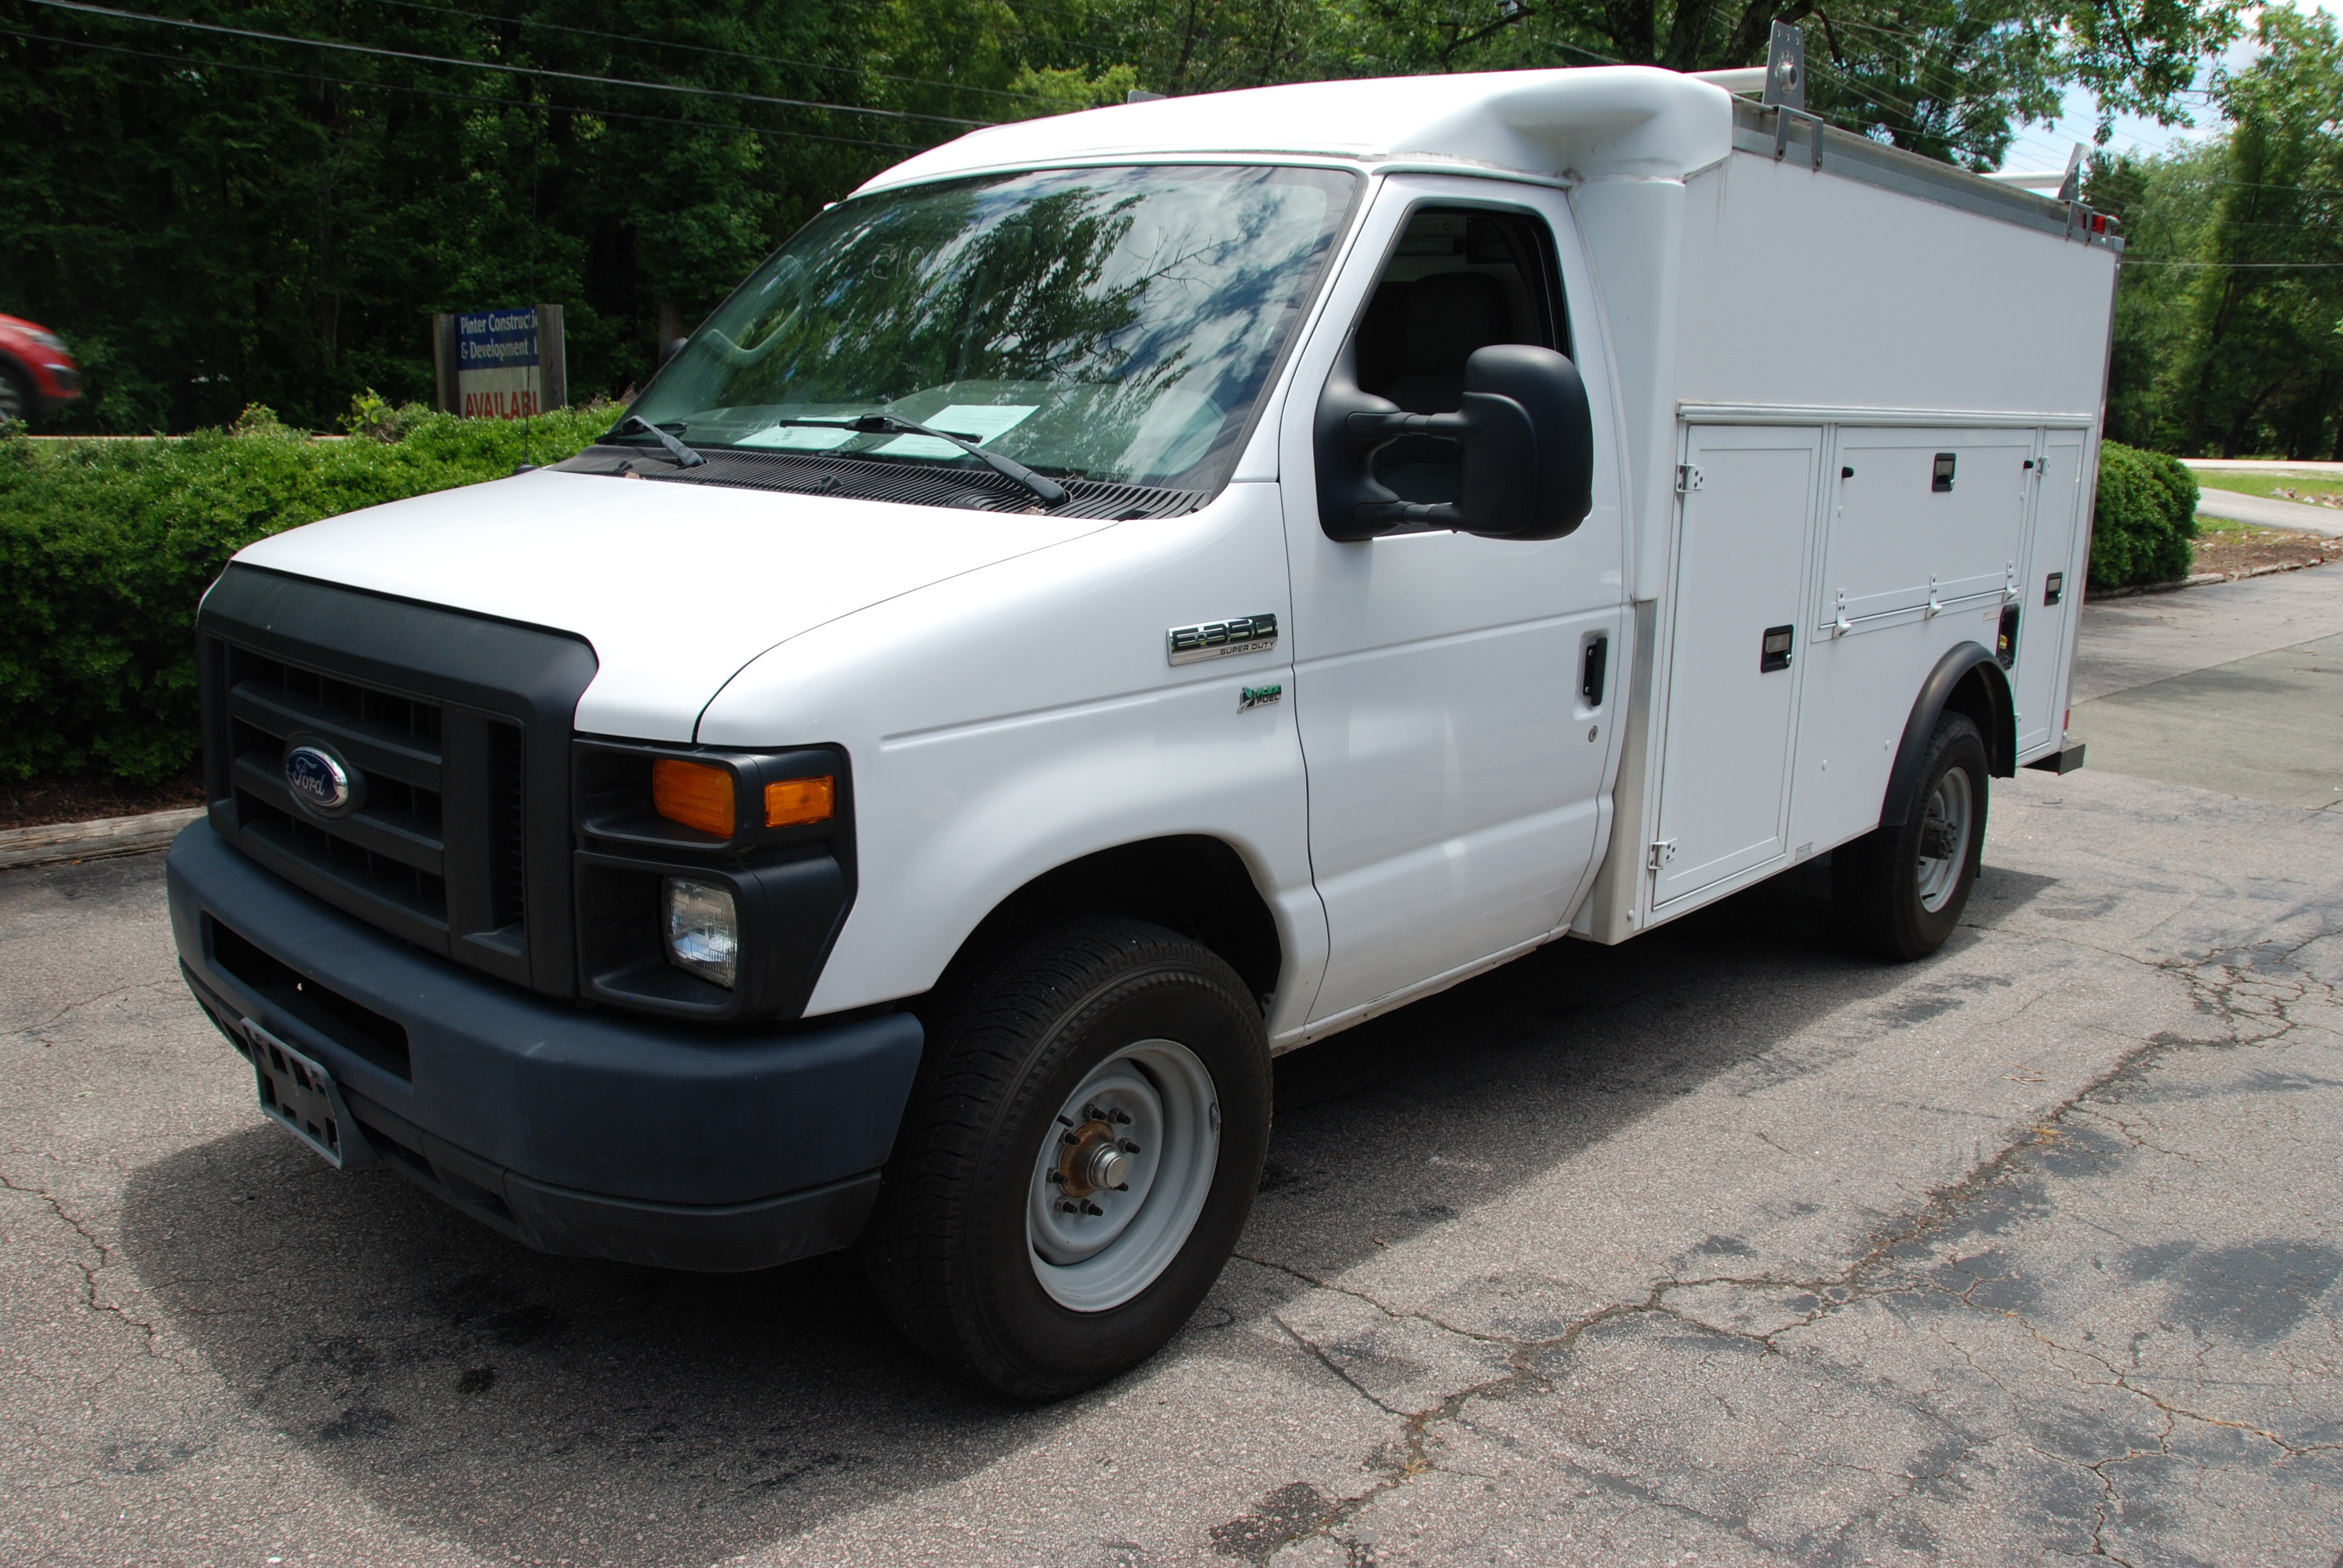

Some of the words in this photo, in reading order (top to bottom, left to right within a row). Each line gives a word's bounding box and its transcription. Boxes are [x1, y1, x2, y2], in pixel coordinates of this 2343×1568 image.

[460, 316, 487, 334] Pinter
[461, 341, 468, 359] &
[1171, 615, 1277, 652] E-350
[1220, 645, 1248, 655] SUPER
[1251, 641, 1275, 650] DUTY
[1257, 684, 1279, 696] FLEX
[1257, 694, 1279, 705] FUEL
[293, 757, 325, 795] Ford
